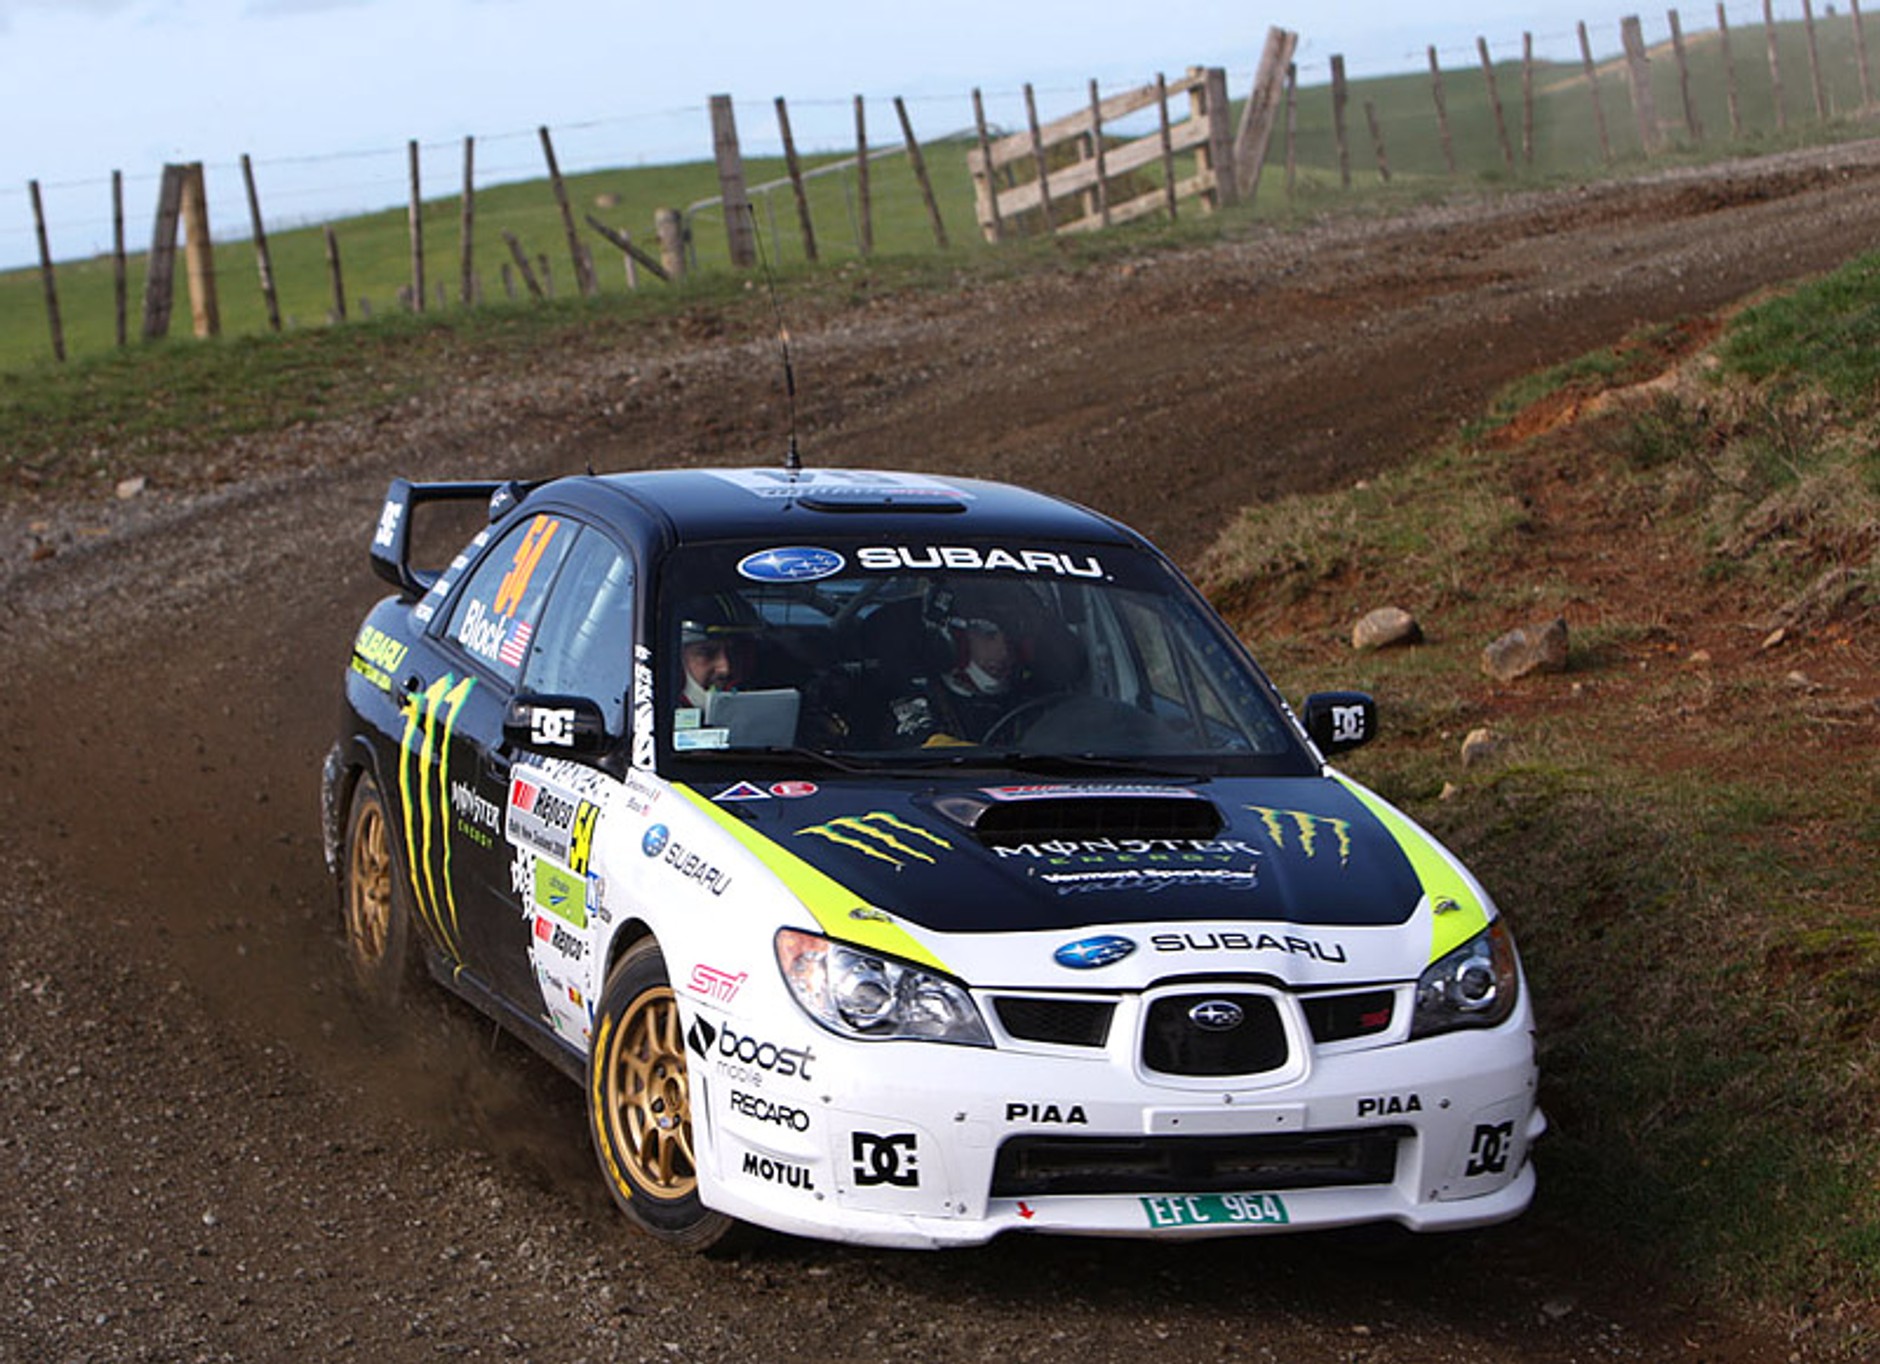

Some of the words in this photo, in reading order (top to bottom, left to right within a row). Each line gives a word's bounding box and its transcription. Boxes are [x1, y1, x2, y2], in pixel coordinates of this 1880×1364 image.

[494, 514, 559, 617] 54
[355, 625, 408, 673] SUBARU
[458, 600, 507, 661] Block
[531, 708, 575, 746] DC
[1332, 705, 1364, 742] DC
[533, 786, 574, 828] Repco
[992, 838, 1263, 857] MONSTER
[1049, 854, 1231, 865] ENERGY
[664, 843, 732, 897] SUBARU
[1041, 870, 1140, 882] Vermont
[552, 923, 583, 961] Repco
[1151, 933, 1347, 963] SUBARU
[719, 1021, 816, 1081] boost
[717, 1060, 763, 1088] mobile
[731, 1089, 810, 1132] RECARO
[1006, 1102, 1088, 1124] PIAA
[1358, 1094, 1422, 1117] PIAA
[852, 1131, 919, 1187] DC
[1465, 1120, 1514, 1177] DC
[742, 1153, 815, 1191] MOTUL
[1153, 1197, 1211, 1225] EFC
[1222, 1195, 1282, 1222] 964
